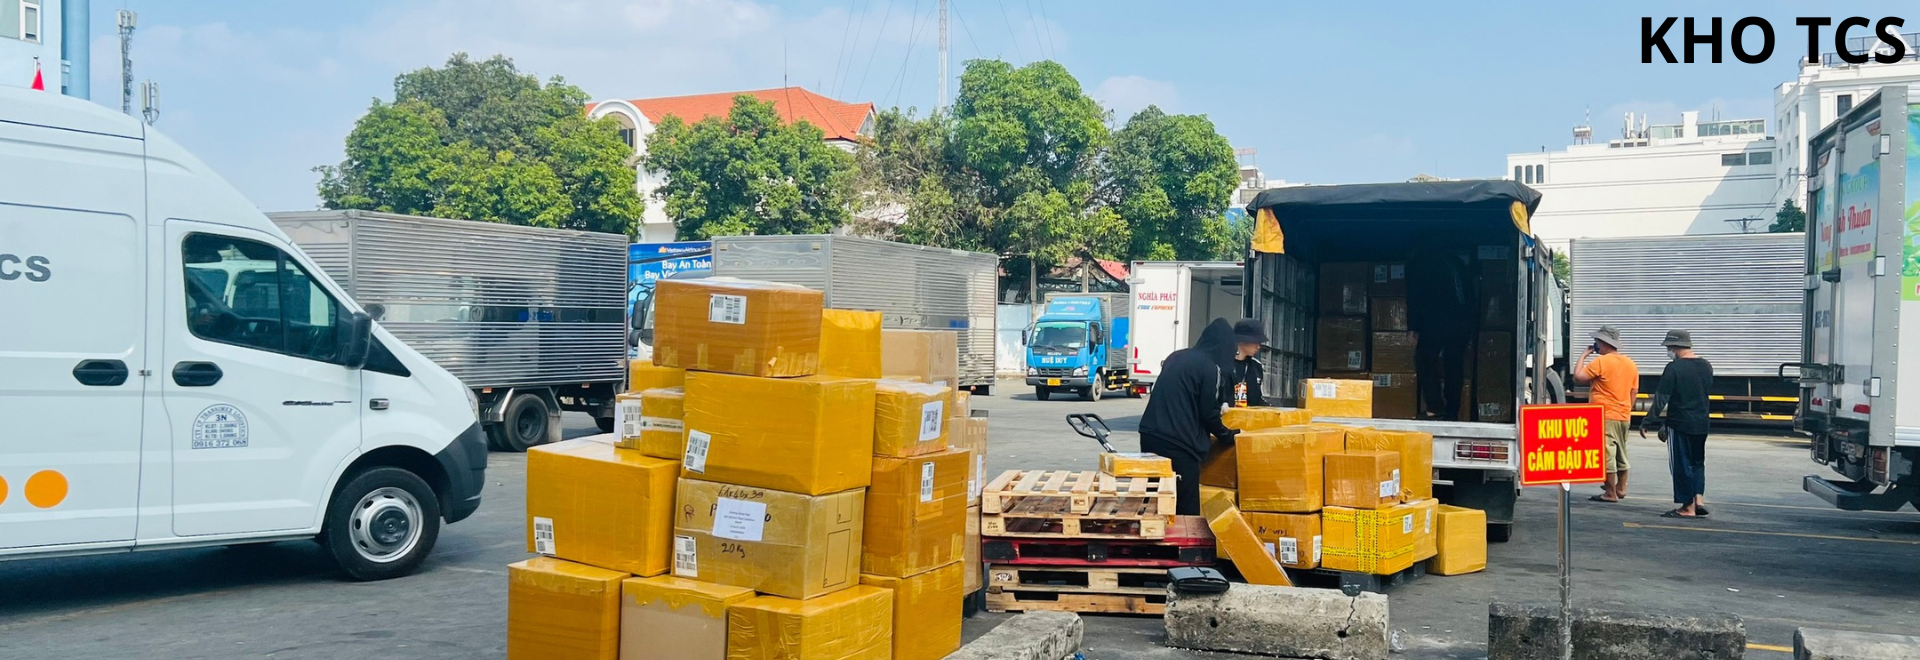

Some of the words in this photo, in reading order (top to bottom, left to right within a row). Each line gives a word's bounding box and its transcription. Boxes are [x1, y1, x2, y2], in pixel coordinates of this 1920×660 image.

[0, 254, 51, 282] CS
[644, 270, 660, 280] Bay
[661, 260, 677, 271] Bay
[679, 260, 691, 269] An
[692, 259, 712, 269] Toàn
[1538, 419, 1562, 439] KHU
[1565, 416, 1588, 442] VỰC
[1528, 444, 1555, 471] CẤM
[1558, 446, 1581, 474] ĐẬU
[1584, 449, 1600, 469] XE
